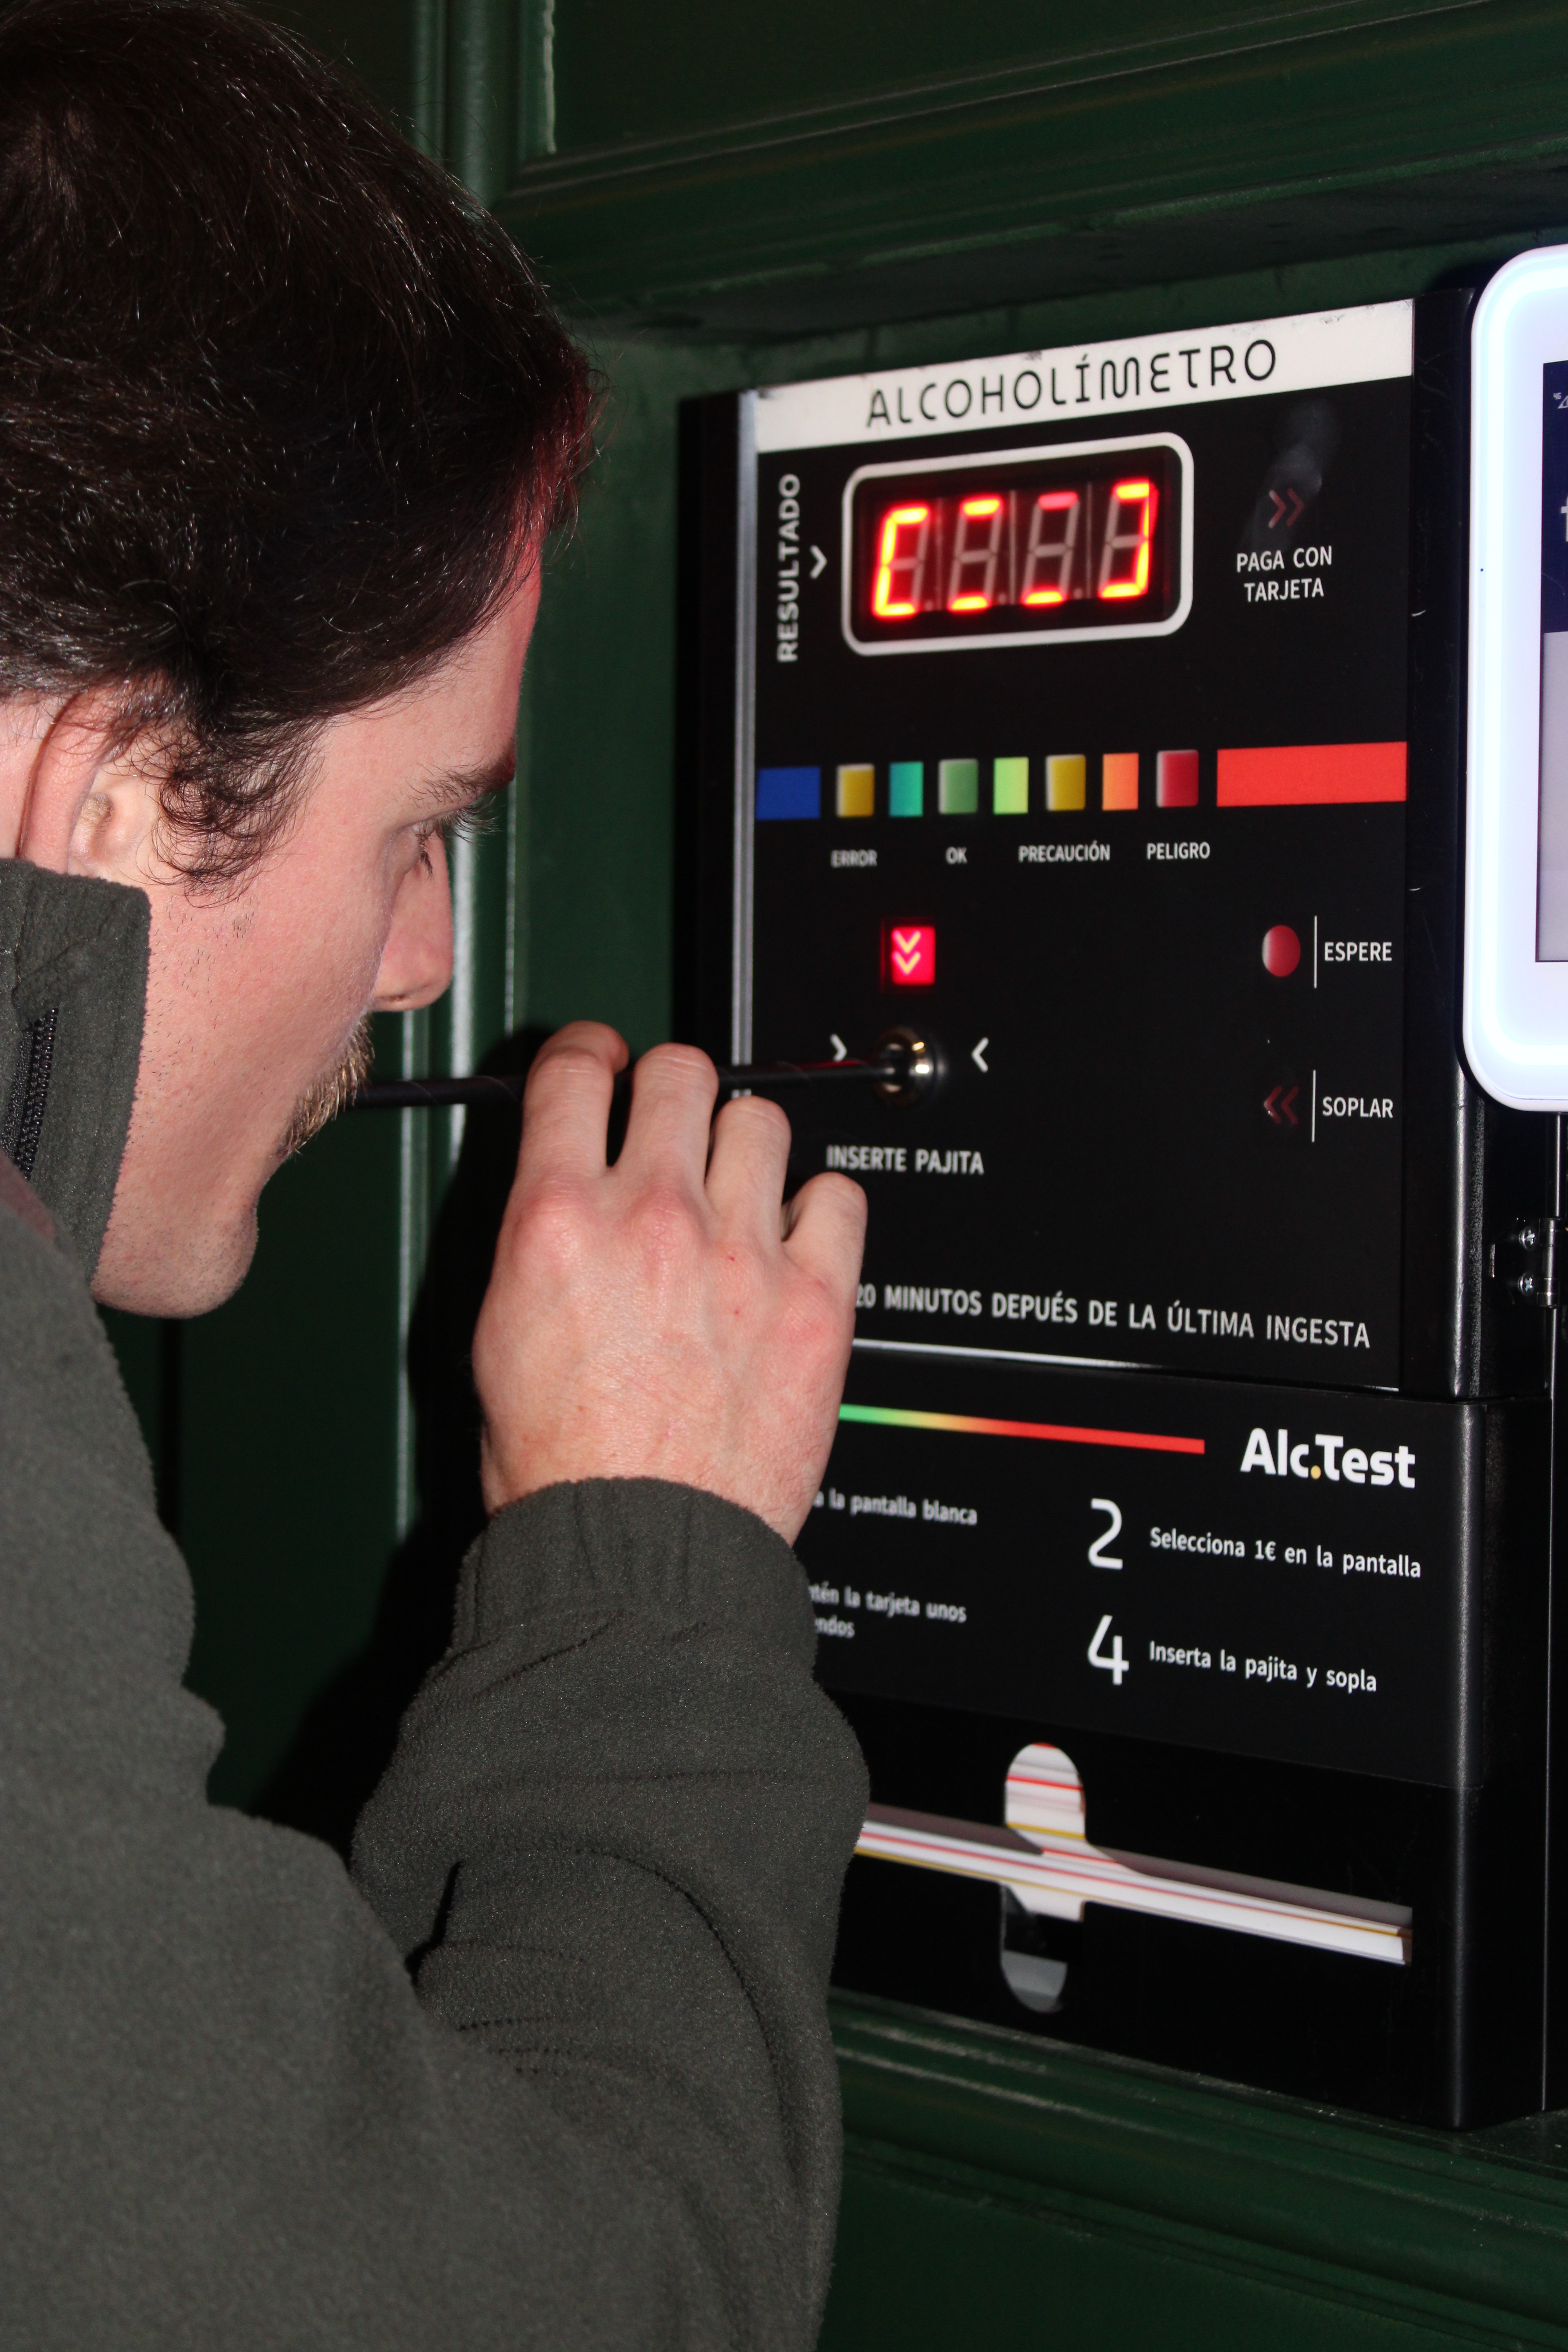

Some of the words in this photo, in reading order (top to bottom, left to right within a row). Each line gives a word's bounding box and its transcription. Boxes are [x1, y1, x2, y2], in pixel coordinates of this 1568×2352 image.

[866, 339, 1276, 427] ALCOHOLÍMETRO
[777, 474, 800, 662] RESULTADO
[1236, 549, 1285, 573] PAGA
[1293, 545, 1332, 568] CON
[1244, 577, 1325, 603] TARJETA
[831, 850, 877, 867] ERROR
[946, 847, 967, 864] OK
[1019, 840, 1111, 862] PRECAUCIÓN
[1147, 841, 1211, 860] PELIGRO
[1324, 941, 1392, 962] ESPERE
[1322, 1096, 1394, 1118] SOPLAR
[827, 1145, 906, 1172] INSERTE
[915, 1149, 984, 1174] PAJITA
[885, 1284, 982, 1316] MINUTOS
[991, 1290, 1078, 1323] DEPUÉS
[1089, 1300, 1118, 1327] DE
[1129, 1303, 1156, 1329] LA
[1167, 1300, 1254, 1338] ÚLTIMA
[1267, 1315, 1370, 1348] INGESTA
[829, 1488, 845, 1510] la
[850, 1494, 917, 1517] pantalla
[922, 1499, 978, 1525] blanca
[1088, 1498, 1123, 1570] 2
[1150, 1527, 1245, 1557] Selecciona
[1255, 1539, 1277, 1561] 1€
[1284, 1547, 1307, 1565] en
[1316, 1544, 1333, 1568] la
[1343, 1553, 1421, 1578] pantalla
[845, 1586, 861, 1608] la
[866, 1592, 920, 1618] tarjeta
[926, 1602, 967, 1623] unos
[815, 1615, 855, 1638] ndos
[1087, 1615, 1130, 1685] 4
[1150, 1641, 1211, 1668] Inserta
[1220, 1649, 1236, 1671] la
[1245, 1655, 1298, 1682] pajita
[1306, 1666, 1318, 1688] y
[1326, 1668, 1377, 1694] sopla
